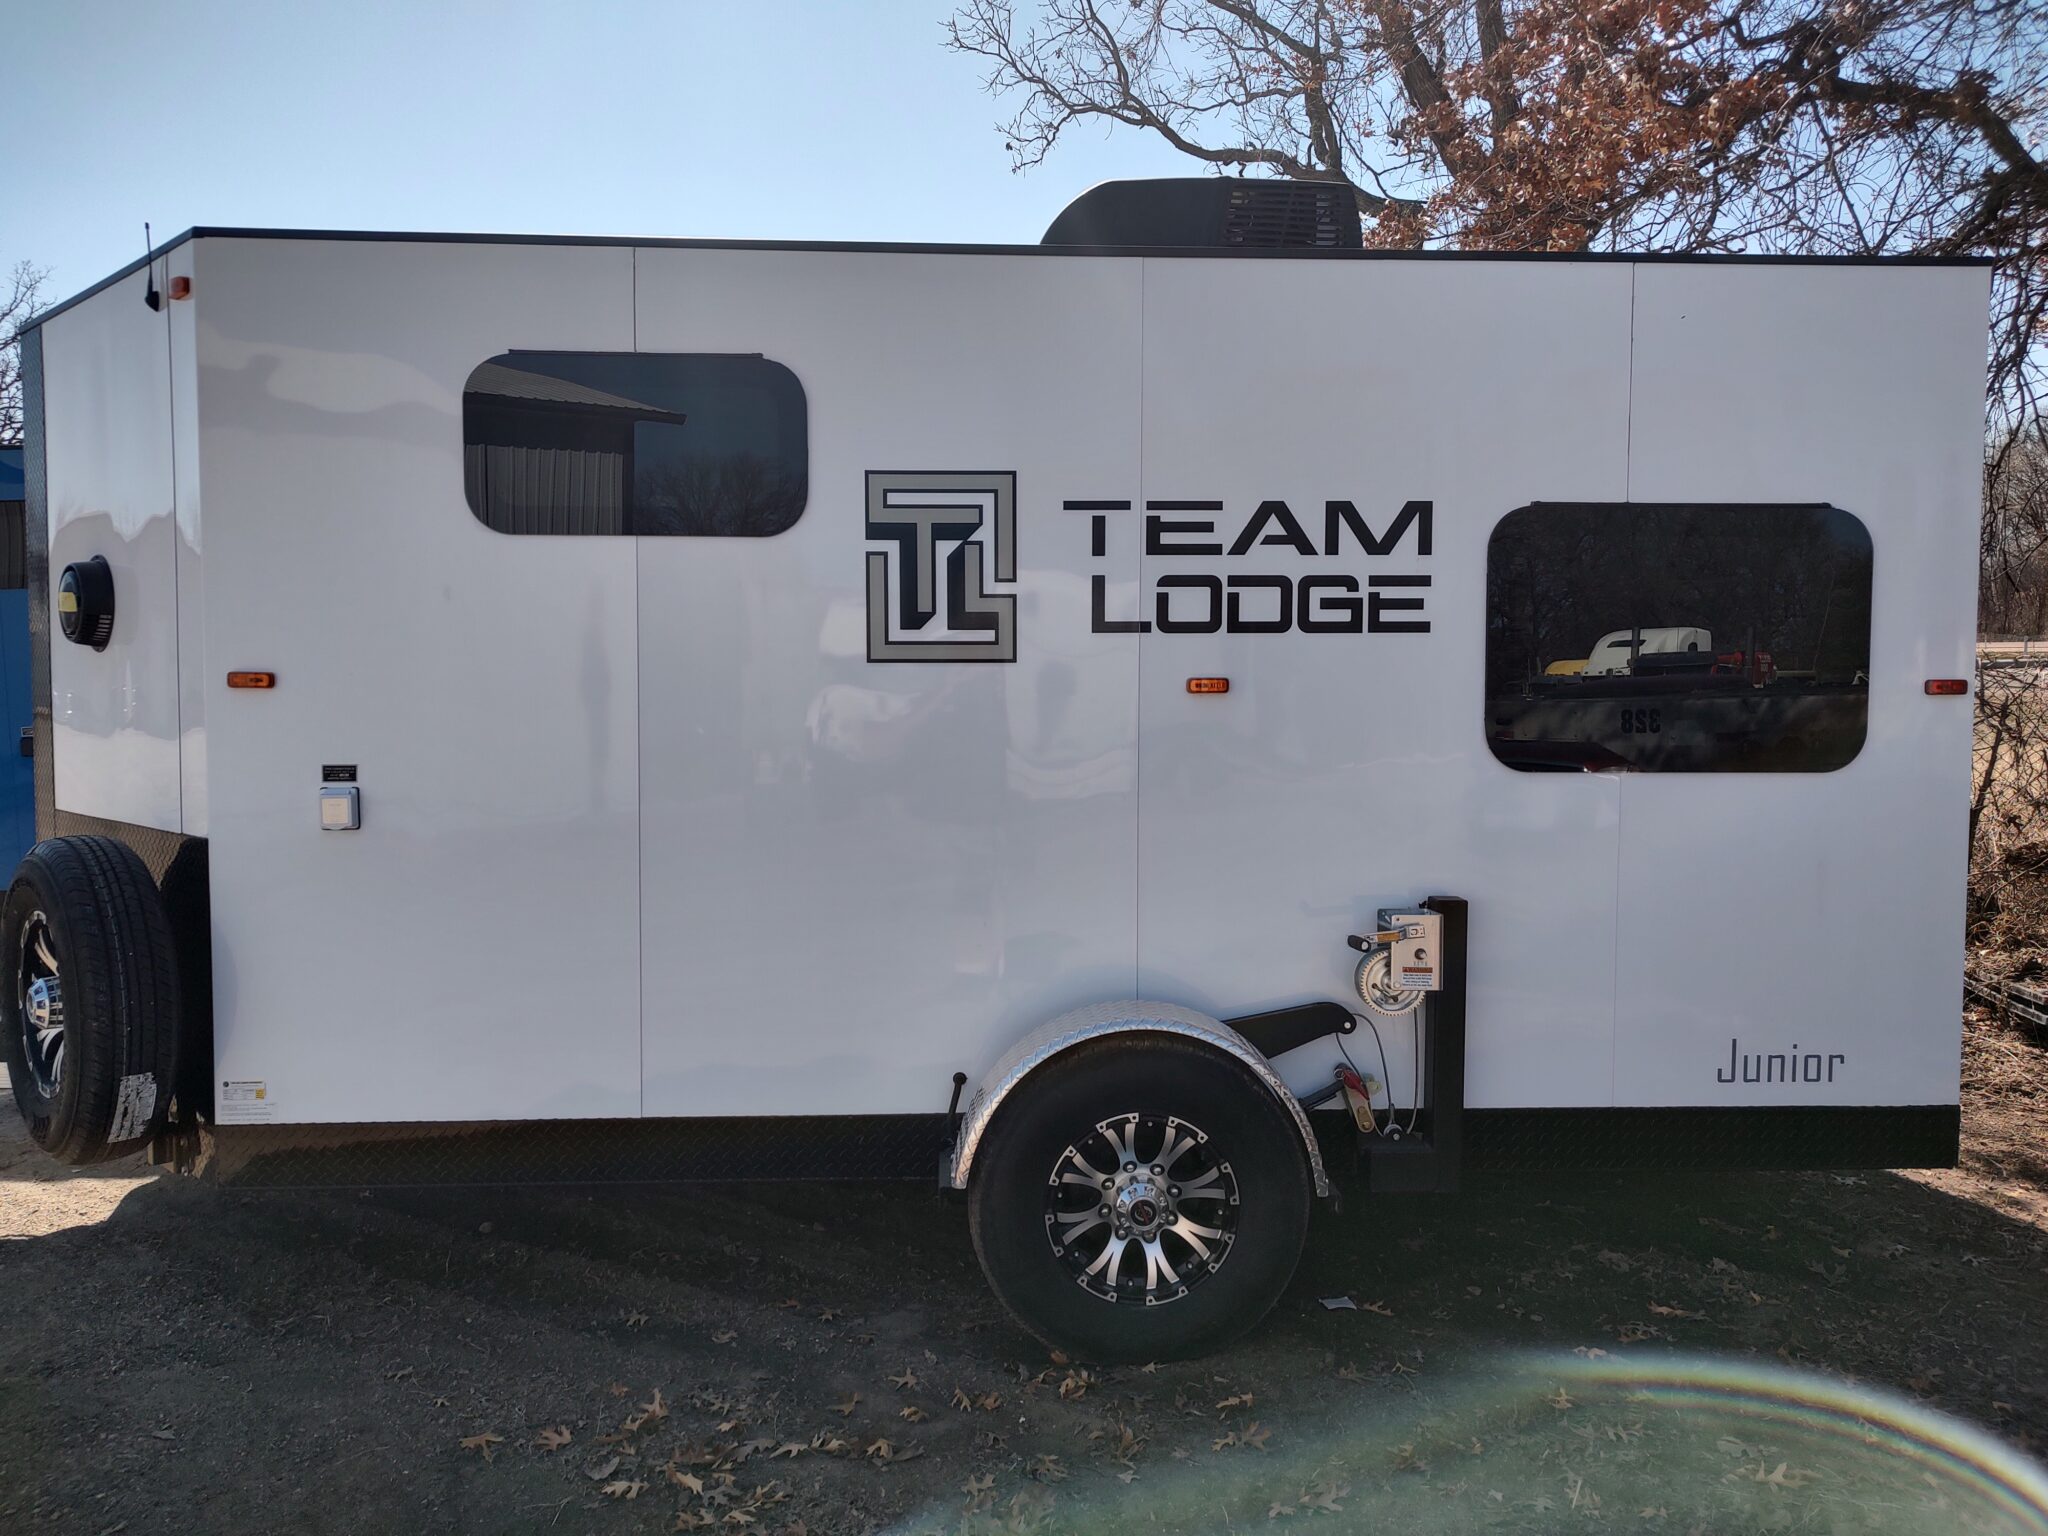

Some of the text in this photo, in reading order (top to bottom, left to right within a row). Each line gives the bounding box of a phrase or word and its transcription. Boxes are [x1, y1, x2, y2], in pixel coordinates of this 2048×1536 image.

[1063, 500, 1433, 556] TEAM
[1091, 574, 1432, 633] LODGE
[1717, 1038, 1845, 1082] Junior
